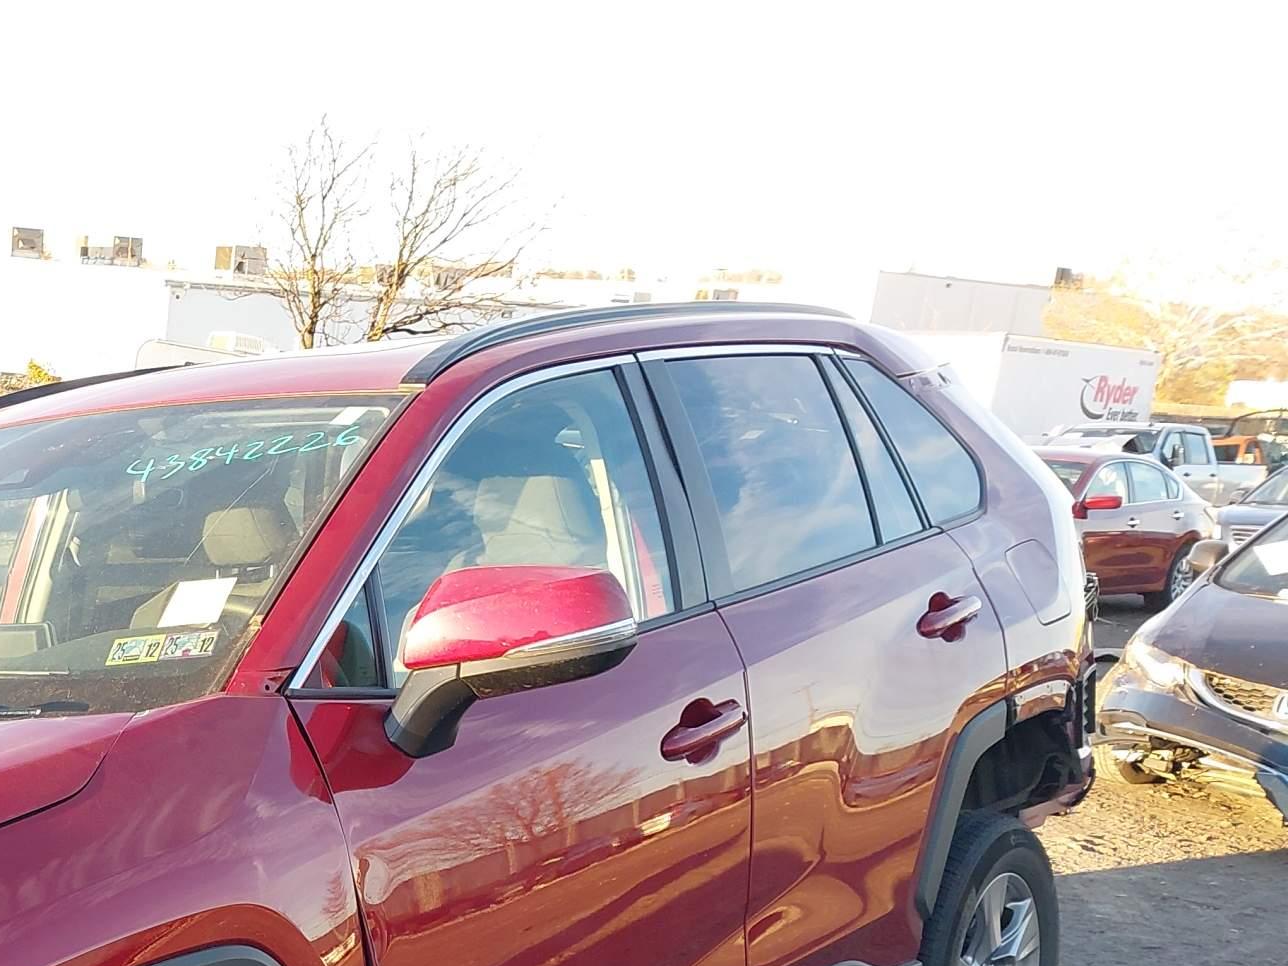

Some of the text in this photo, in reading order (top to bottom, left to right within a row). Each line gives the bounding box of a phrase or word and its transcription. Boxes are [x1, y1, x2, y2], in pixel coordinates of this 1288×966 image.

[1093, 375, 1139, 409] Ryder
[126, 425, 361, 482] 43842226
[112, 641, 160, 660] 25 12
[164, 636, 215, 655] 25 12
